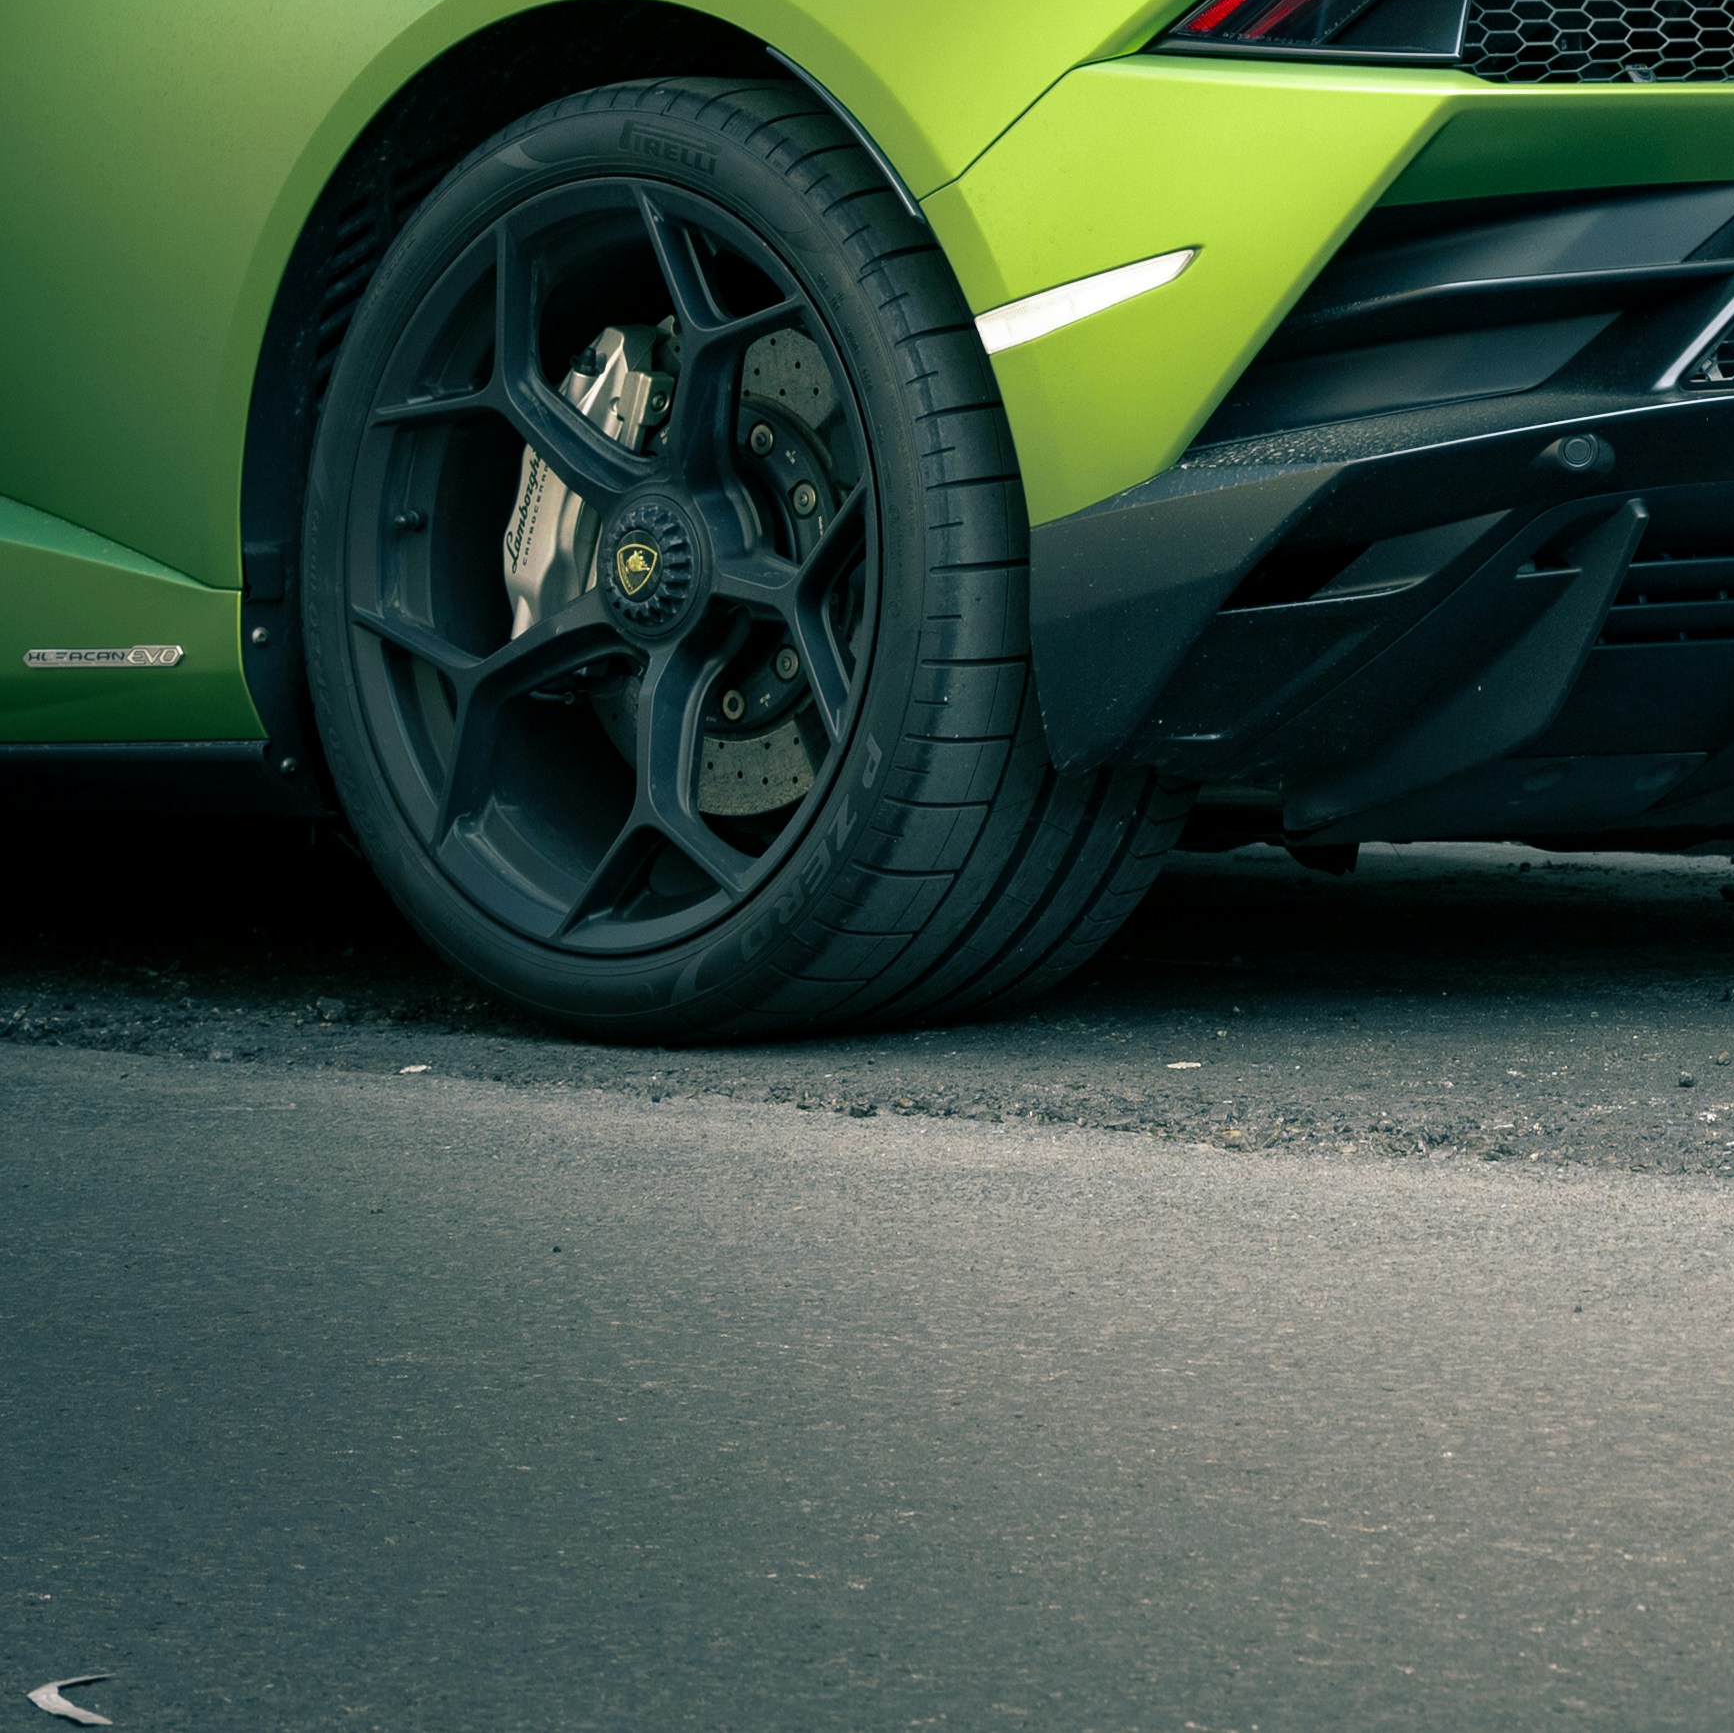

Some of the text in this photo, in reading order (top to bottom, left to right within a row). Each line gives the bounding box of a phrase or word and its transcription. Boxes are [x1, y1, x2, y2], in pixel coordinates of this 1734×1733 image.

[618, 119, 723, 176] PIRELLI
[126, 647, 180, 665] EVO
[740, 732, 883, 962] P ZERO
